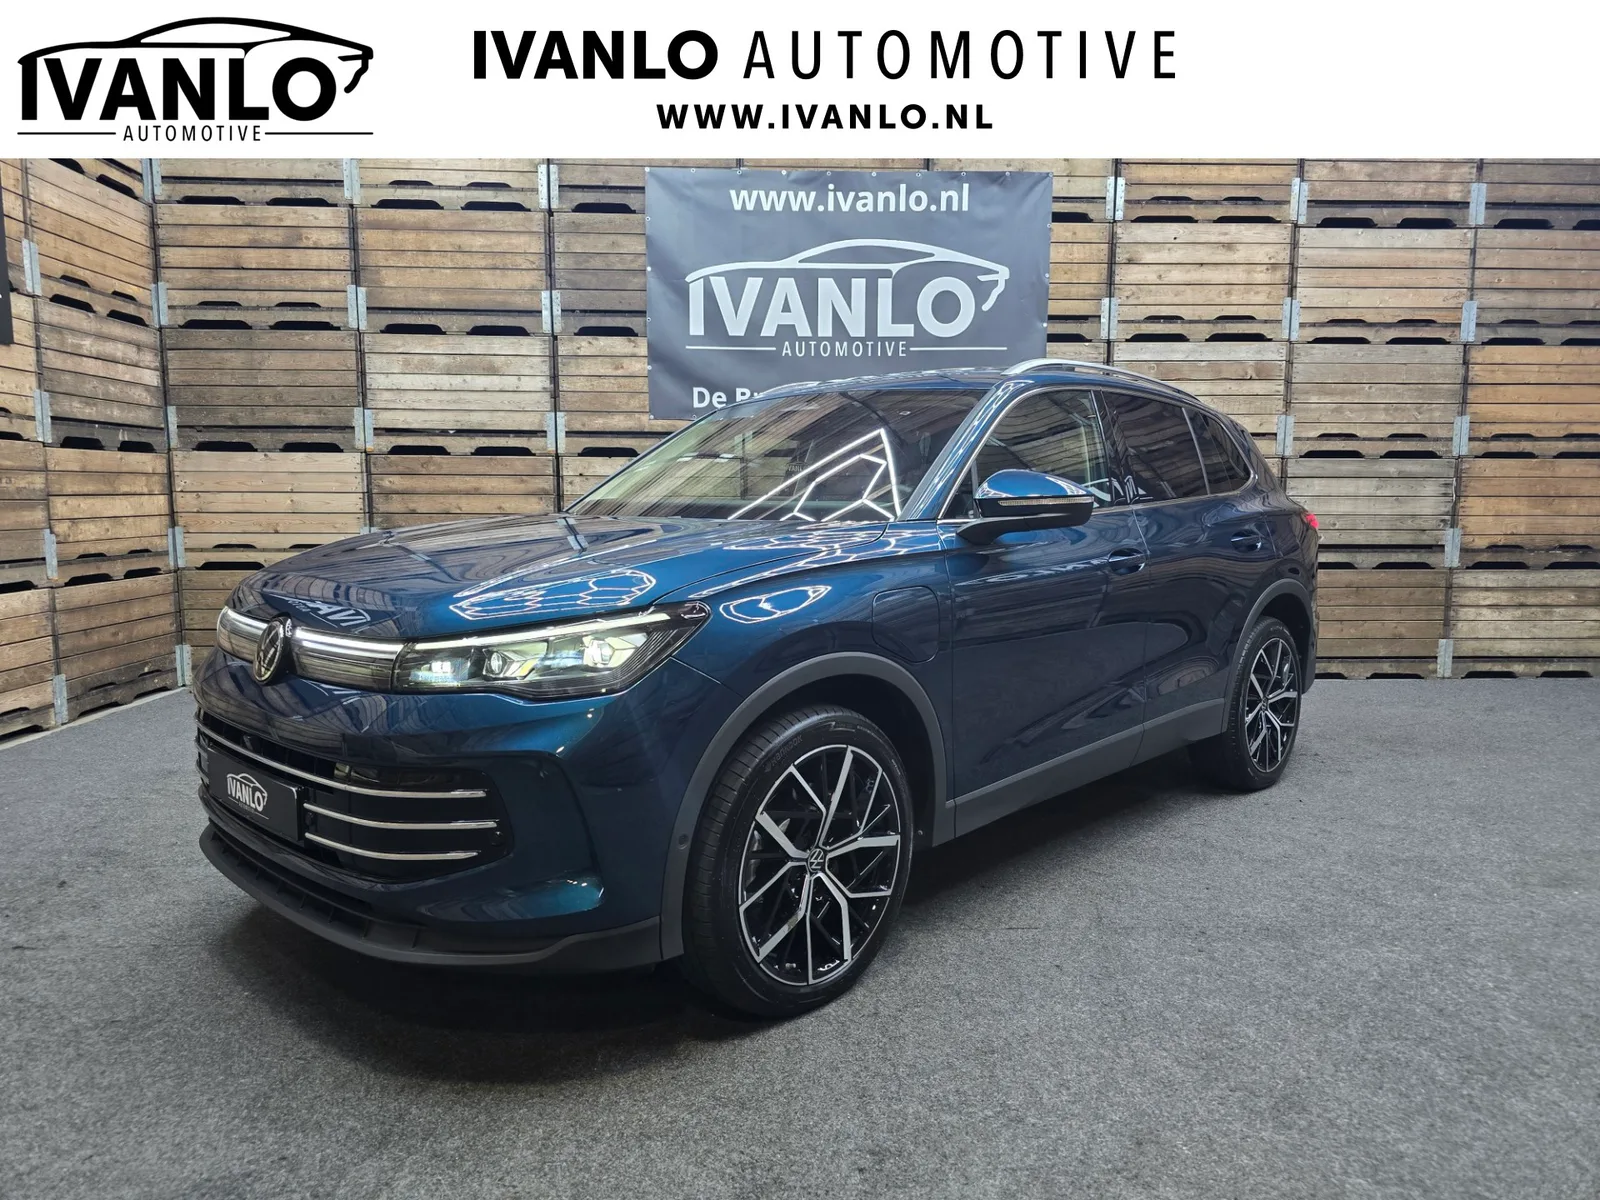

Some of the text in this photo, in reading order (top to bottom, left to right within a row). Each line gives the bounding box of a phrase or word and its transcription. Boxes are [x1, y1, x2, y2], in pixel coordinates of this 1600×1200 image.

[729, 183, 970, 213] www.ivanlo.nl
[688, 276, 976, 338] IVANLO
[781, 341, 907, 358] AUTOMOTIVE
[692, 386, 728, 409] De
[227, 777, 264, 812] IVANLO
